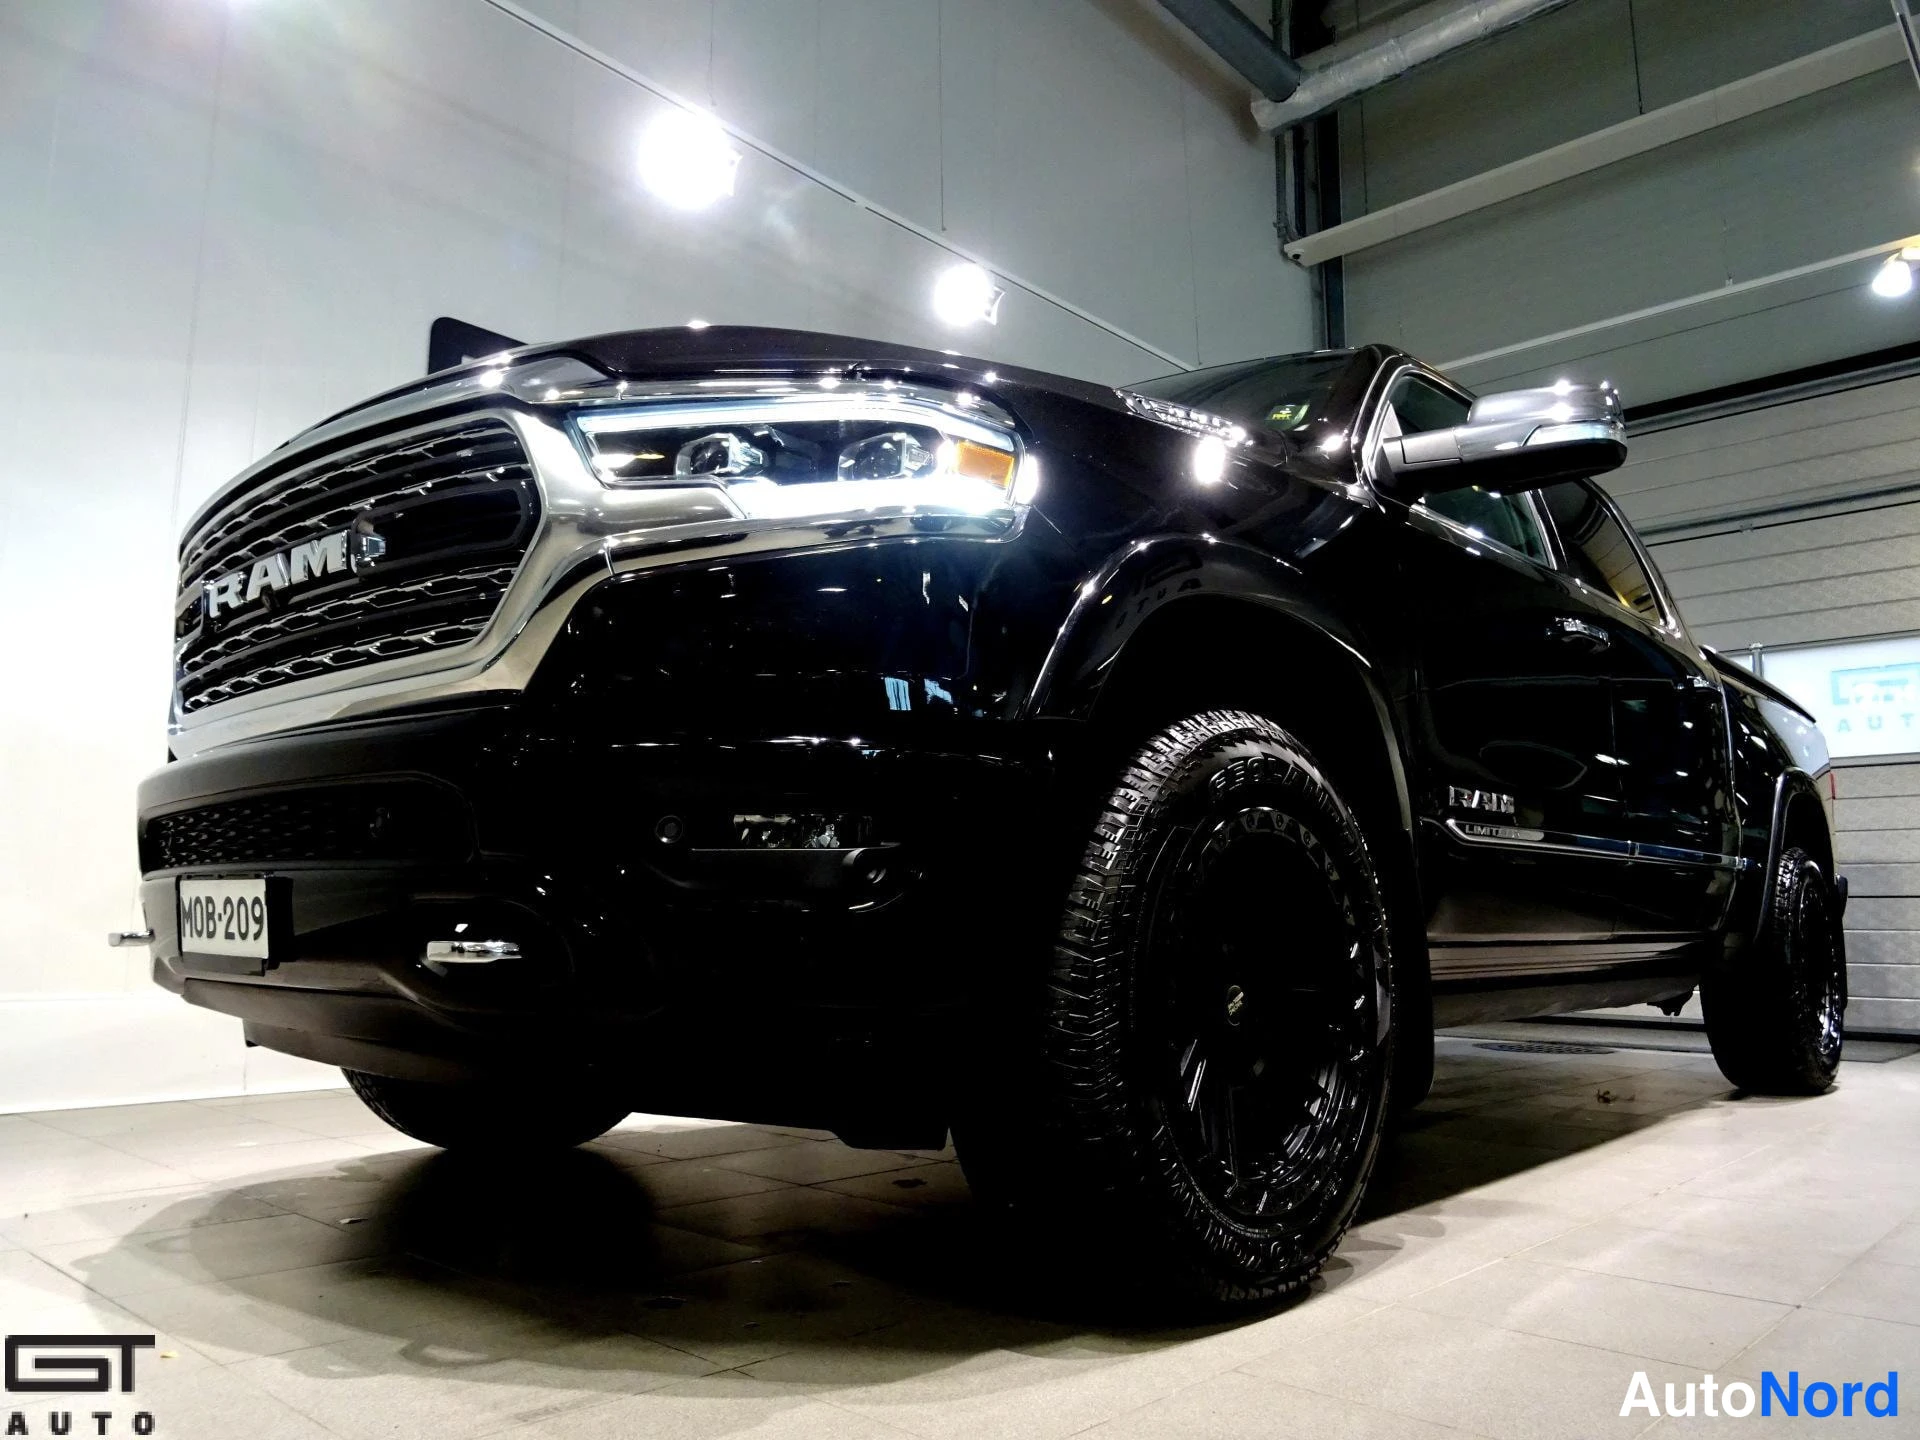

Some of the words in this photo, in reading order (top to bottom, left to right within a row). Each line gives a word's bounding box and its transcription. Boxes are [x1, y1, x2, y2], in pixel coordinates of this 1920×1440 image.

[203, 529, 349, 619] RAM
[1448, 785, 1515, 814] RAM
[181, 895, 264, 942] MOB-209
